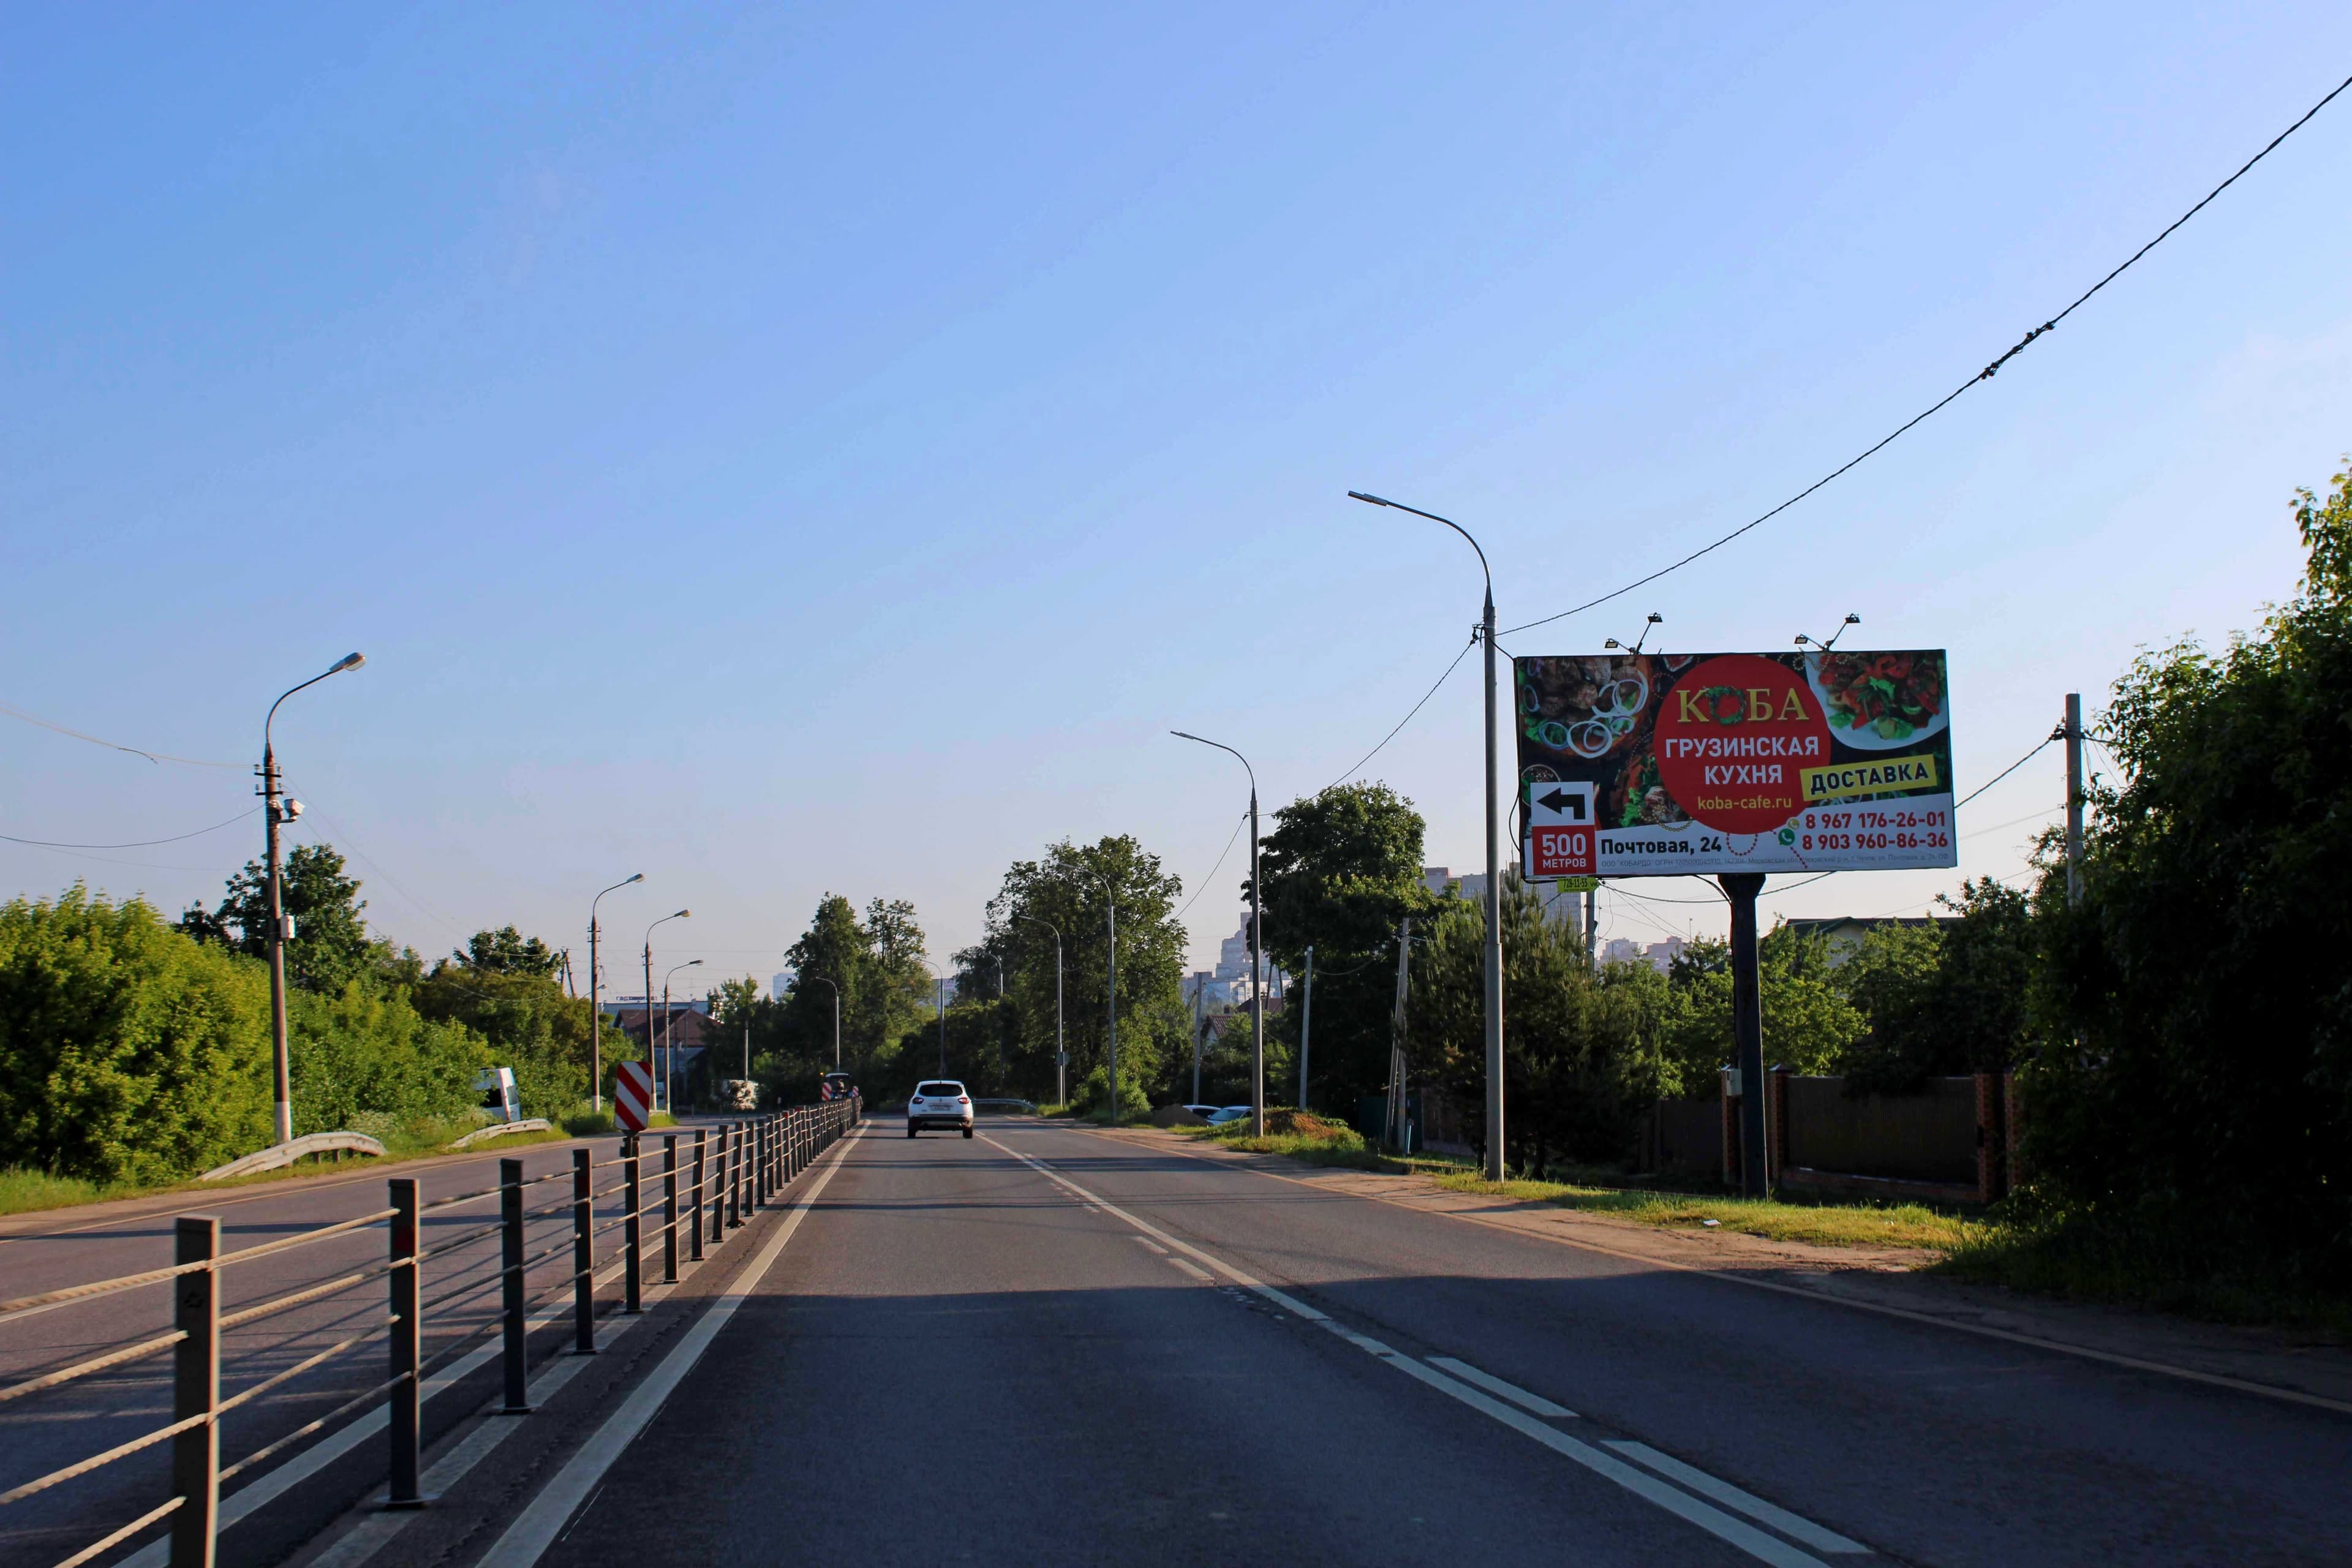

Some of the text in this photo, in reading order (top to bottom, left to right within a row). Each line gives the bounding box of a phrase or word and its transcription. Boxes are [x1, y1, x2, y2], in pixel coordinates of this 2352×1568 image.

[1676, 686, 1809, 725] КОБА
[1665, 736, 1819, 758] ГРУЗИНСКАЯ
[1705, 764, 1782, 785] КУХНЯ
[1810, 762, 1929, 796] ДОСТАВКА
[1698, 795, 1792, 810] koba-cafe.ru
[1806, 812, 1945, 829] 8 967 176-26-01
[1542, 833, 1586, 857] 500
[1600, 836, 1722, 856] Почтовая, 24
[1802, 832, 1948, 850] 8 903 960-86-36
[1542, 858, 1586, 869] МЕТРОВ
